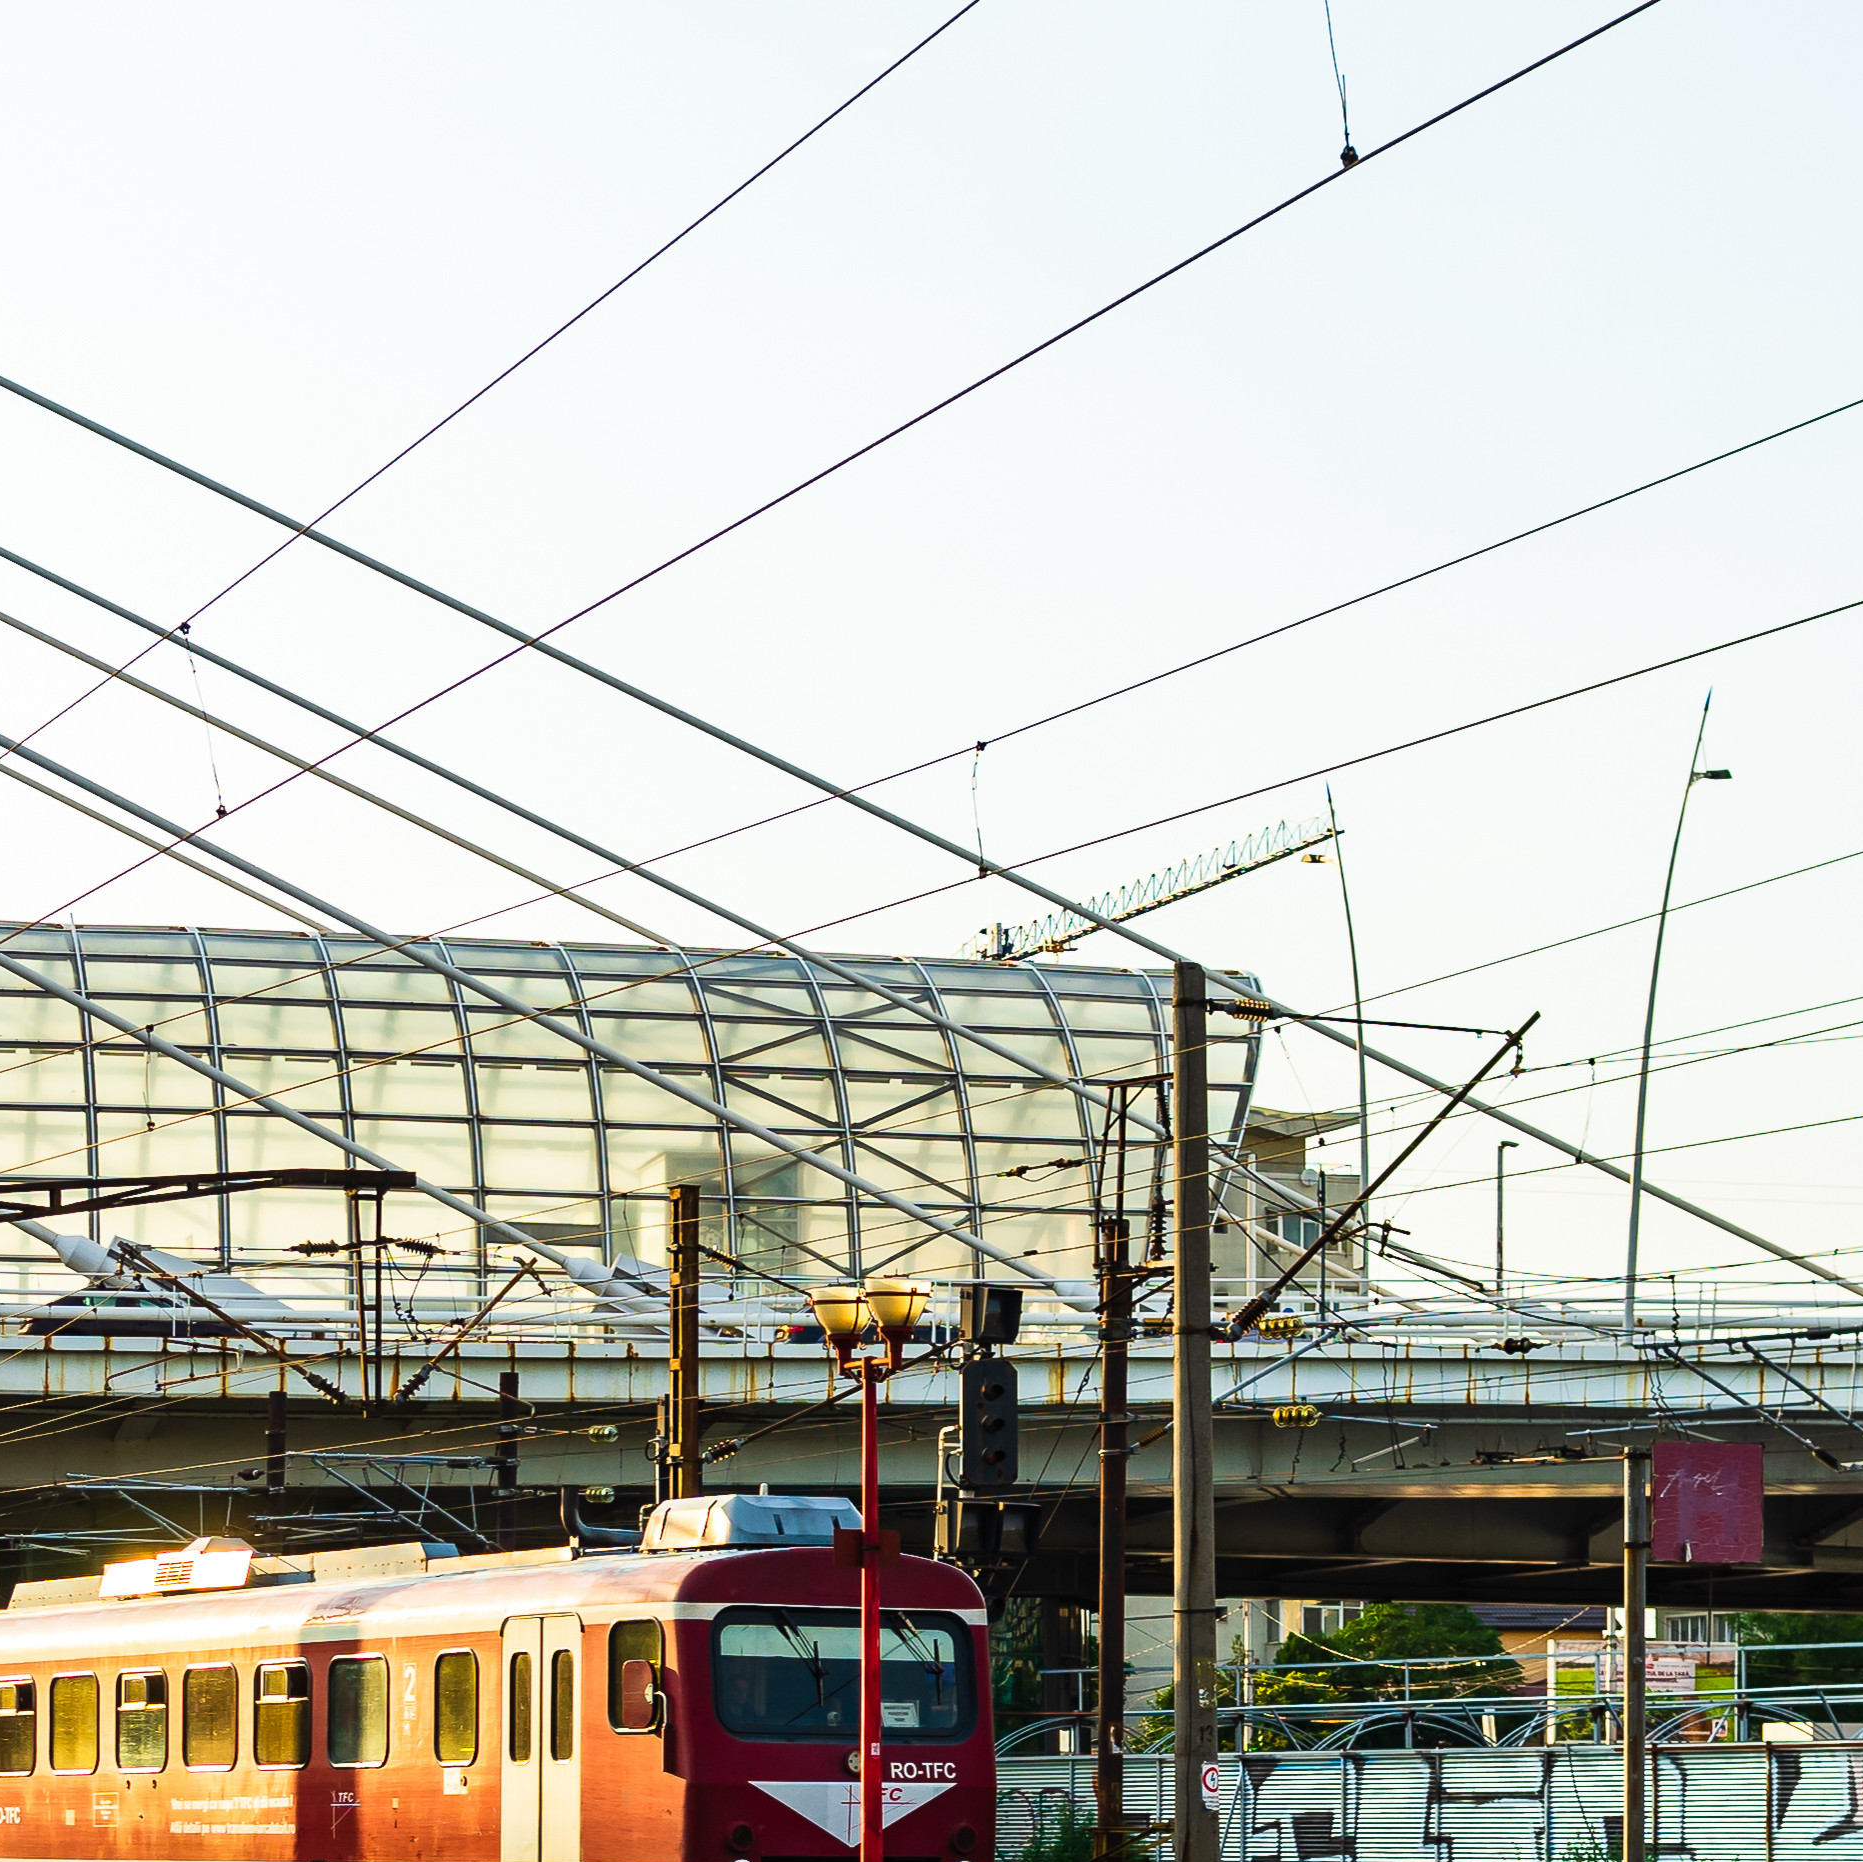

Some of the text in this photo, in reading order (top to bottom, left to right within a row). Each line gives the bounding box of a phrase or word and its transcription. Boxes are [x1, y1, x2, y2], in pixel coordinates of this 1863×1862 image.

[404, 1666, 416, 1702] 2
[890, 1762, 957, 1779] RO-TFC
[338, 1792, 355, 1803] TFC
